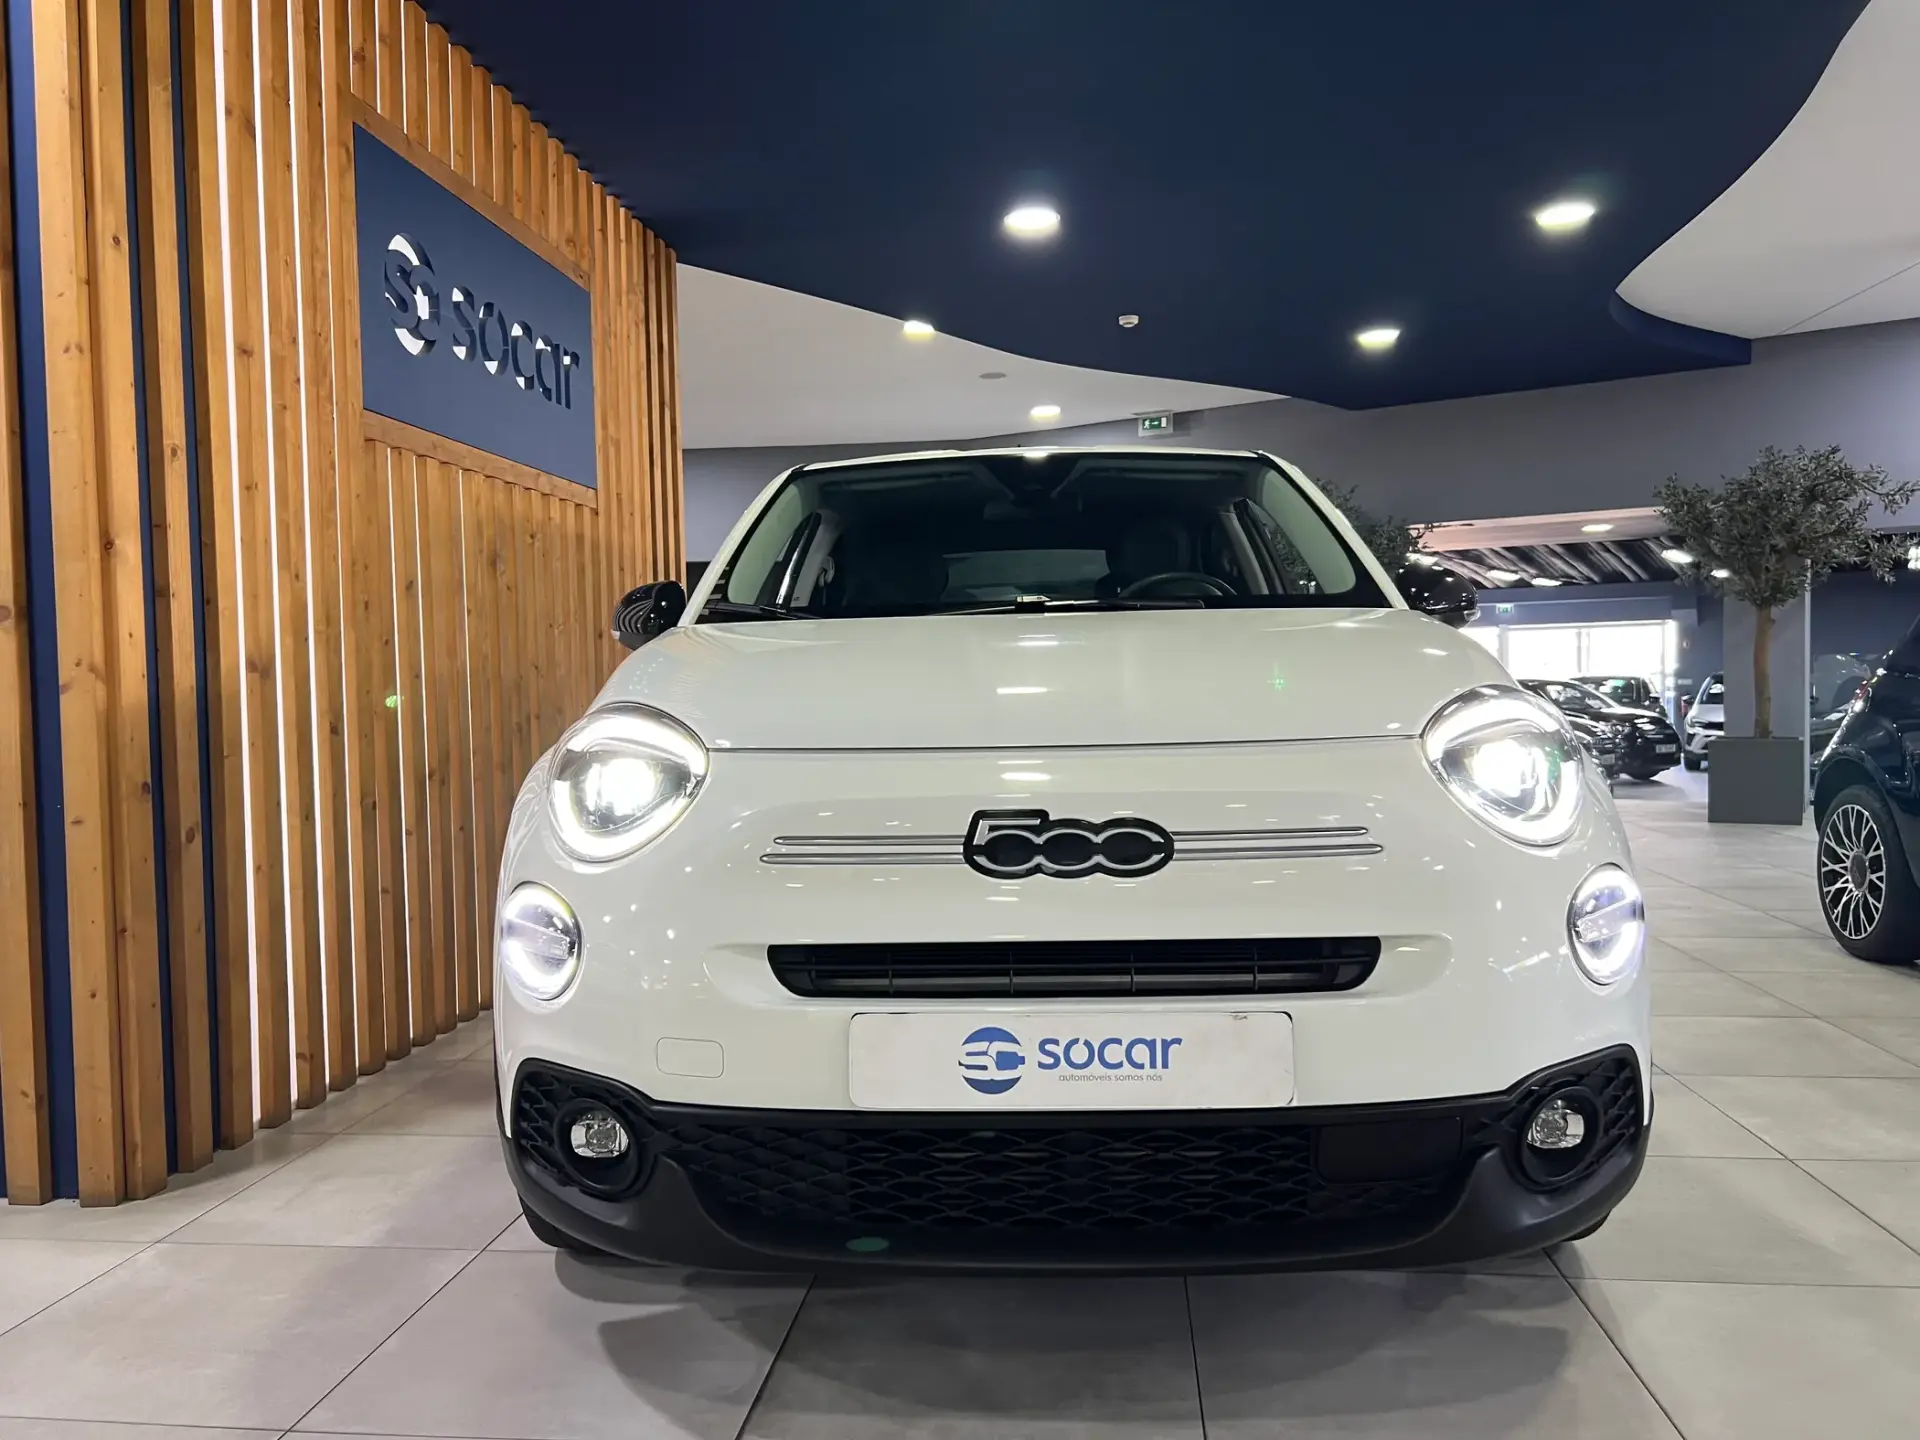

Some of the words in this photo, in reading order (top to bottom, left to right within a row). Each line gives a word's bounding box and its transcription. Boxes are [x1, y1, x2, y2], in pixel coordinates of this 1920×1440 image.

[452, 285, 580, 410] socar
[964, 810, 1173, 878] 500
[1037, 1036, 1183, 1070] socar
[1058, 1072, 1112, 1082] automóveis
[1114, 1074, 1144, 1082] somos
[1146, 1072, 1163, 1082] nós
